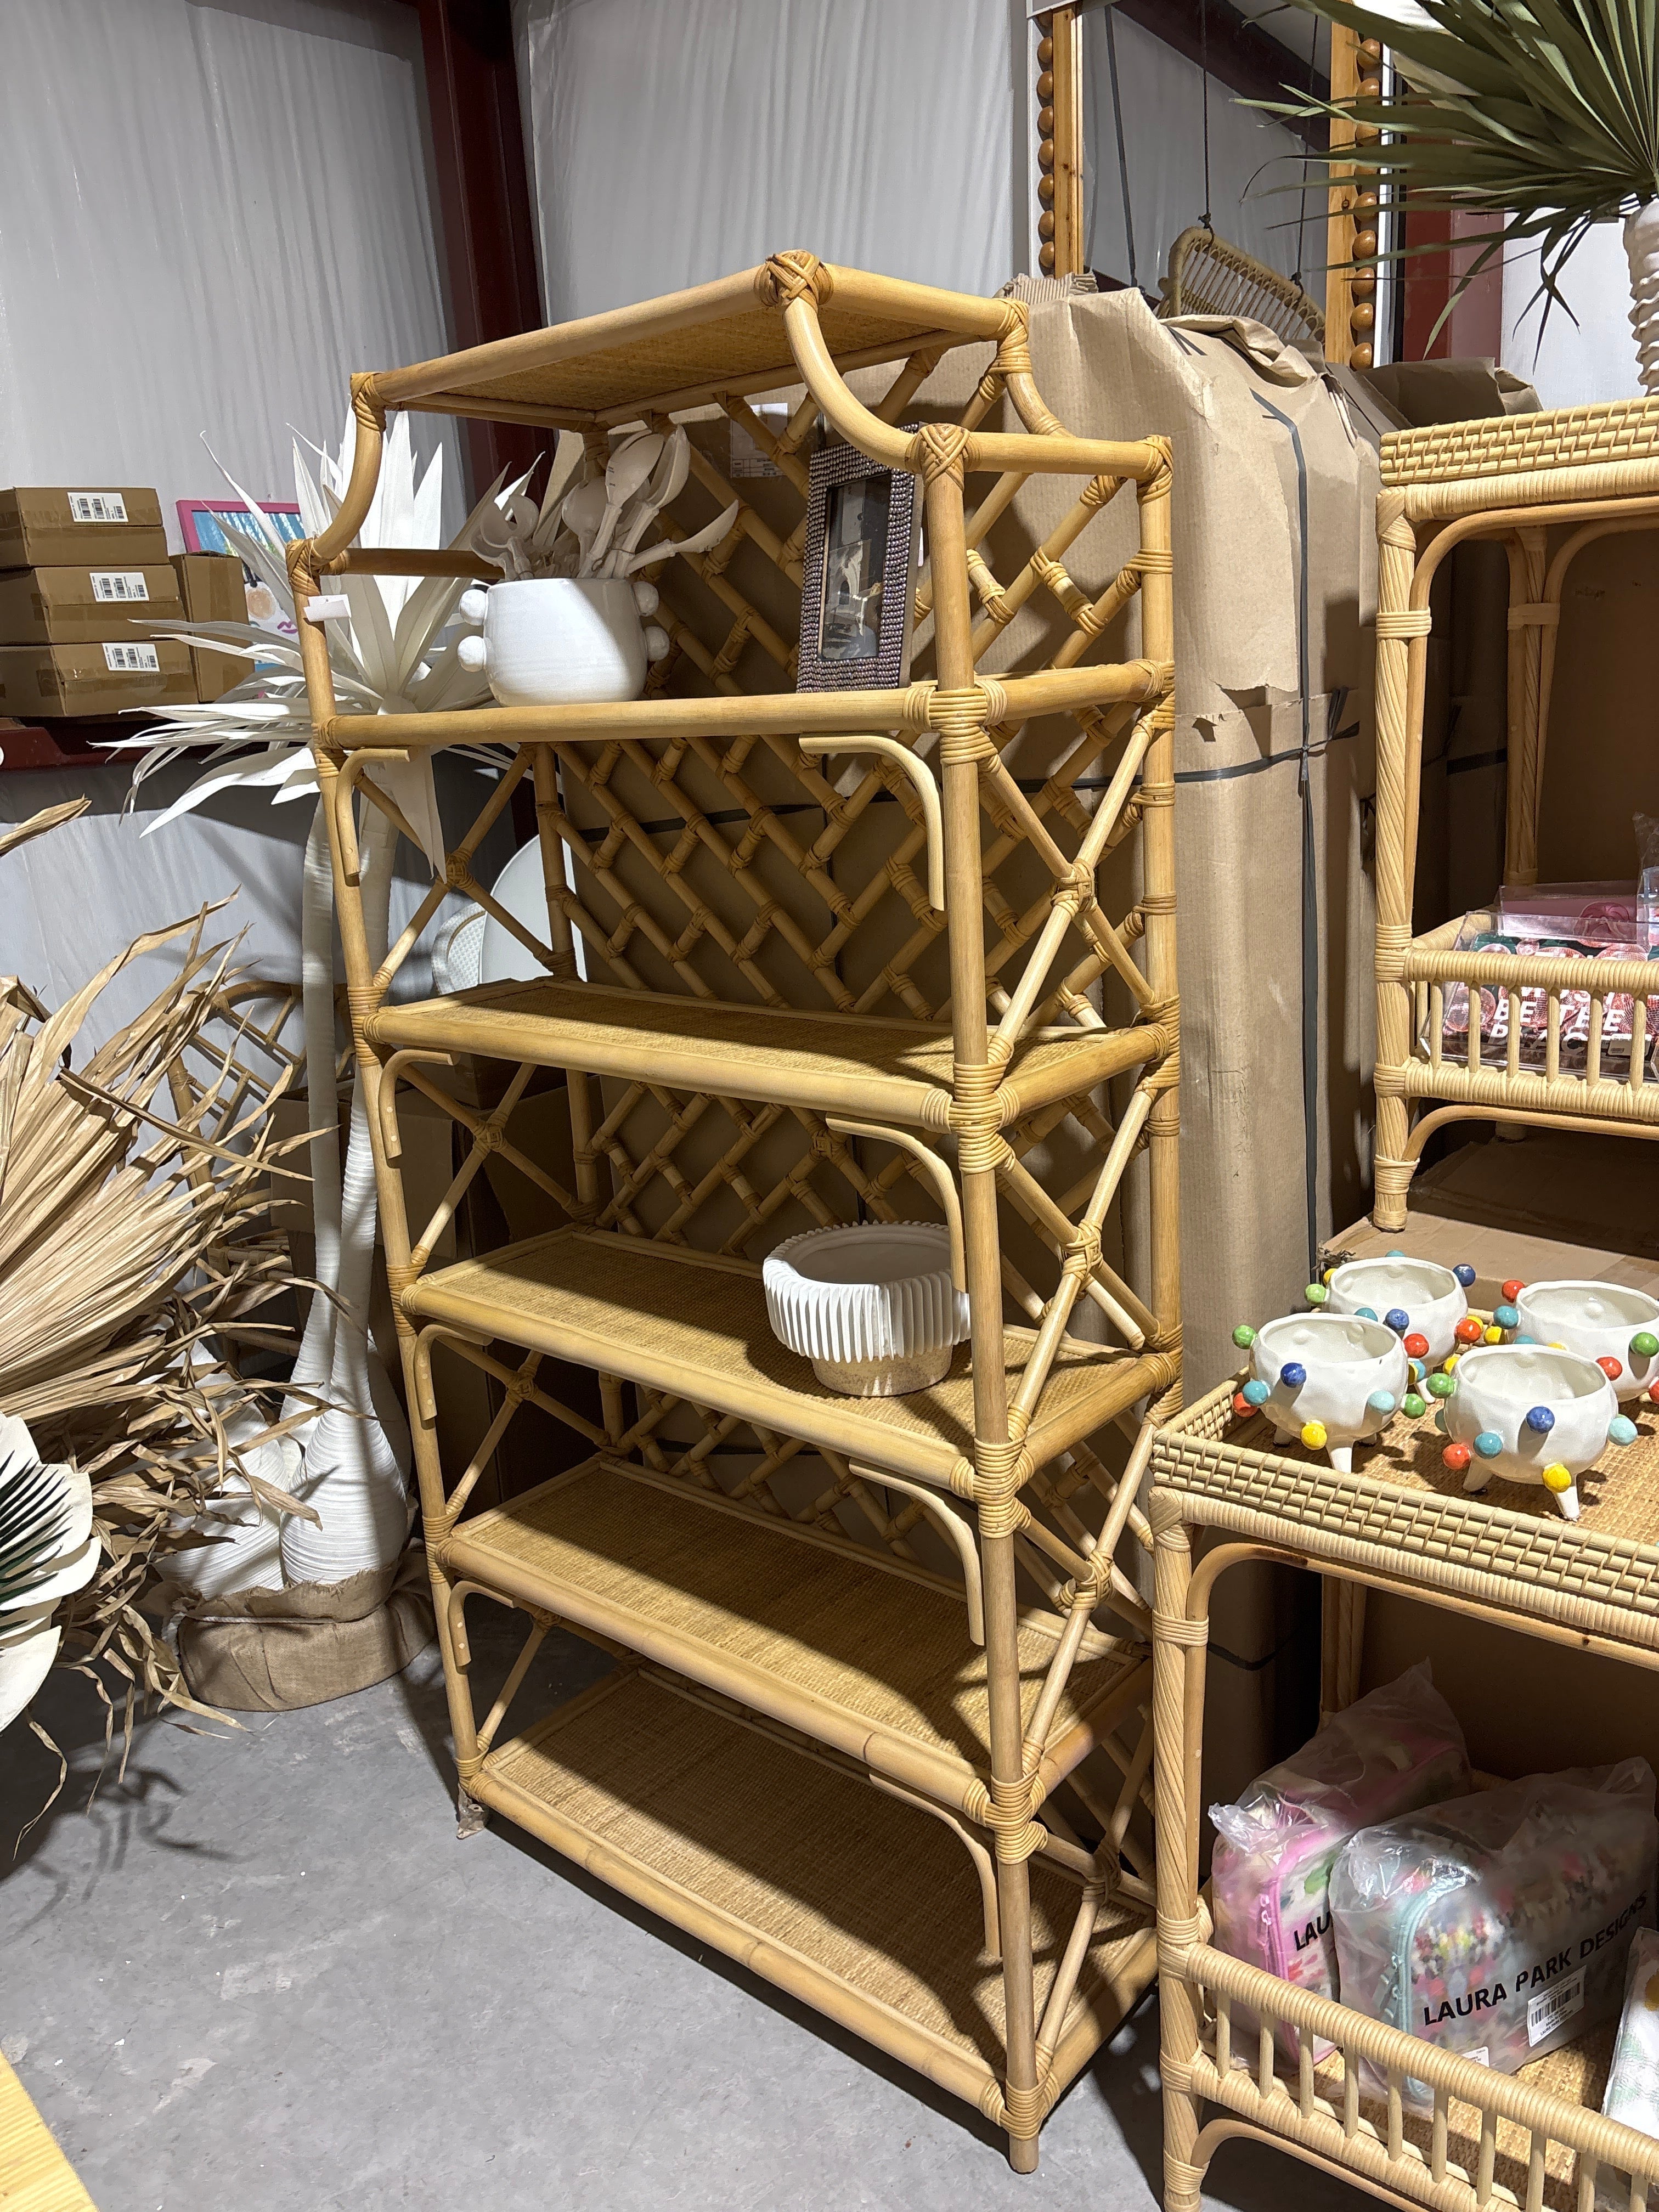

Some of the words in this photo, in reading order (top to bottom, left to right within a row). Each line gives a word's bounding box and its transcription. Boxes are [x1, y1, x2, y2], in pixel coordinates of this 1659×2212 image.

[1294, 1911, 1330, 1951] LAU
[1424, 1983, 1507, 2026] LAURA
[1515, 1947, 1572, 1992] PARK
